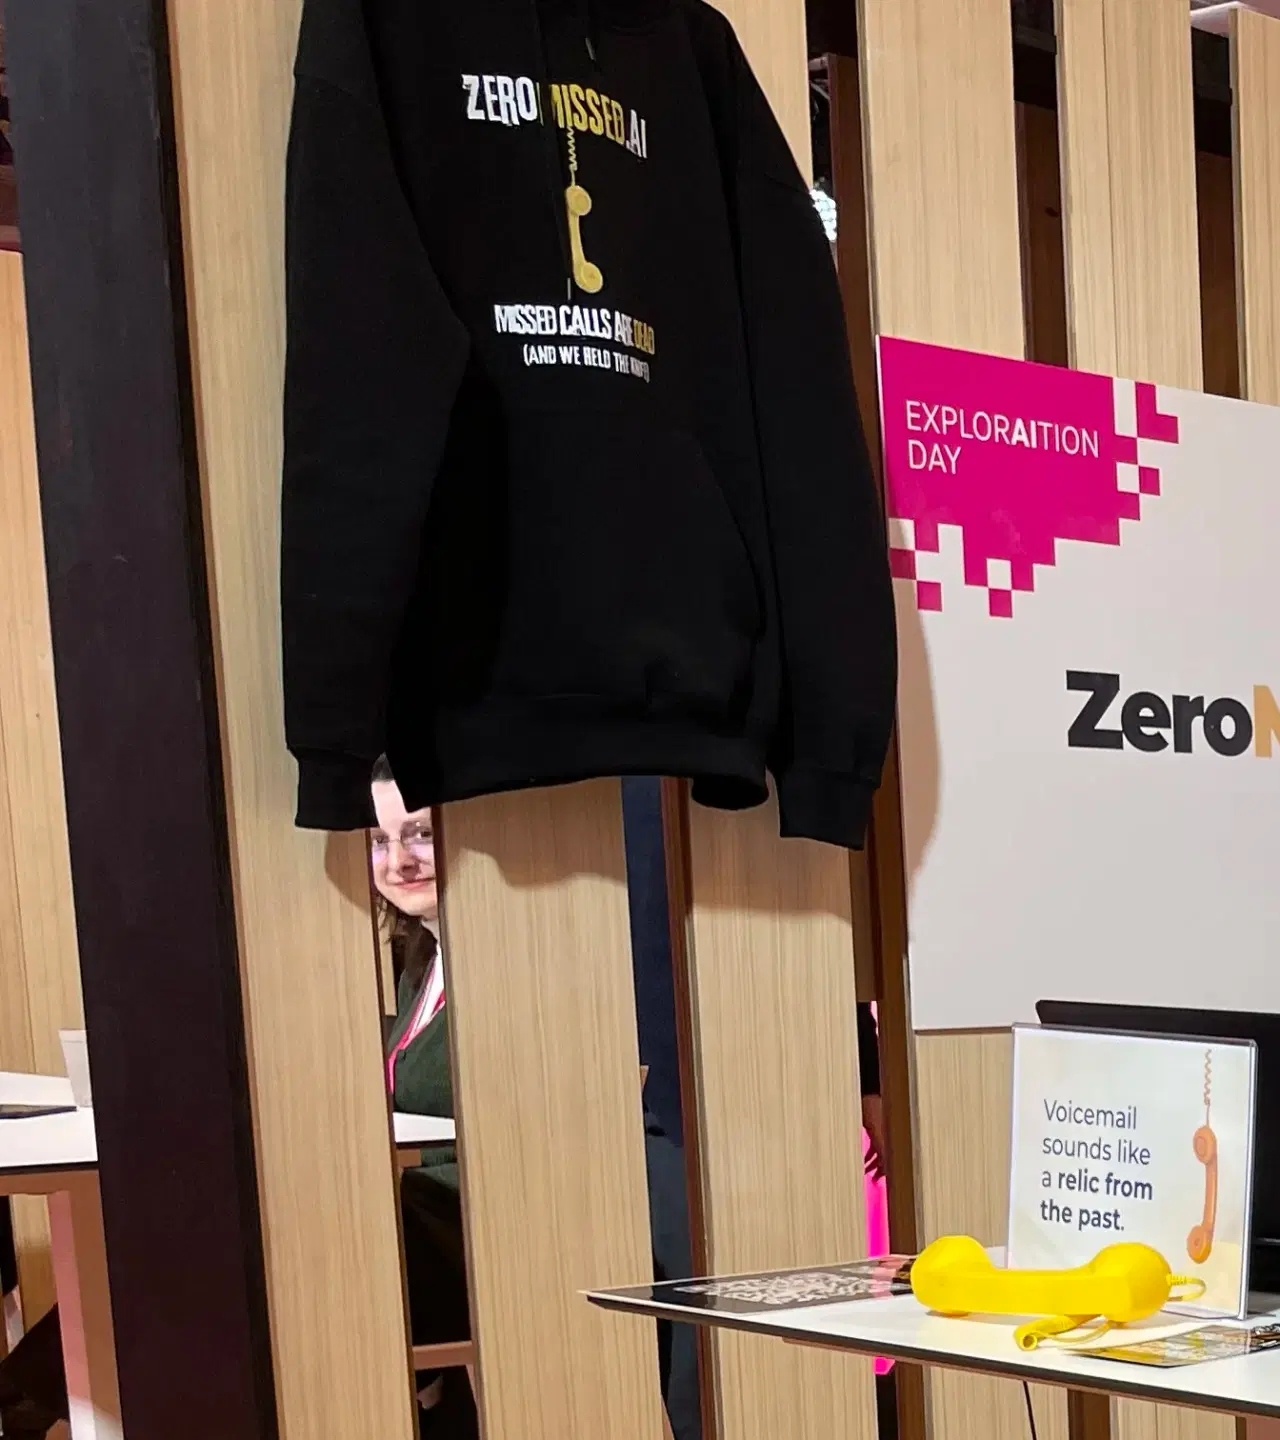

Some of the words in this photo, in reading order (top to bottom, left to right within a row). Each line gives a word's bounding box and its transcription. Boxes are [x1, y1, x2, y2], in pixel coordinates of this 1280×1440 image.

[493, 304, 557, 335] MISSED
[559, 304, 612, 340] CALLS
[614, 310, 634, 347] ARE
[633, 319, 655, 356] DEAD
[523, 343, 557, 366] (AND
[558, 345, 581, 365] WE
[583, 345, 611, 369] HELD
[612, 351, 630, 375] THE
[906, 399, 1099, 458] EXPLORAITION
[907, 439, 961, 475] DAY
[1043, 1099, 1137, 1130] Voicemail
[1042, 1137, 1112, 1161] sounds
[1117, 1139, 1151, 1165] like
[1041, 1170, 1051, 1188] a
[1058, 1167, 1100, 1193] relic
[1105, 1172, 1153, 1201] from
[1040, 1198, 1072, 1223] the
[1078, 1208, 1124, 1231] past.
